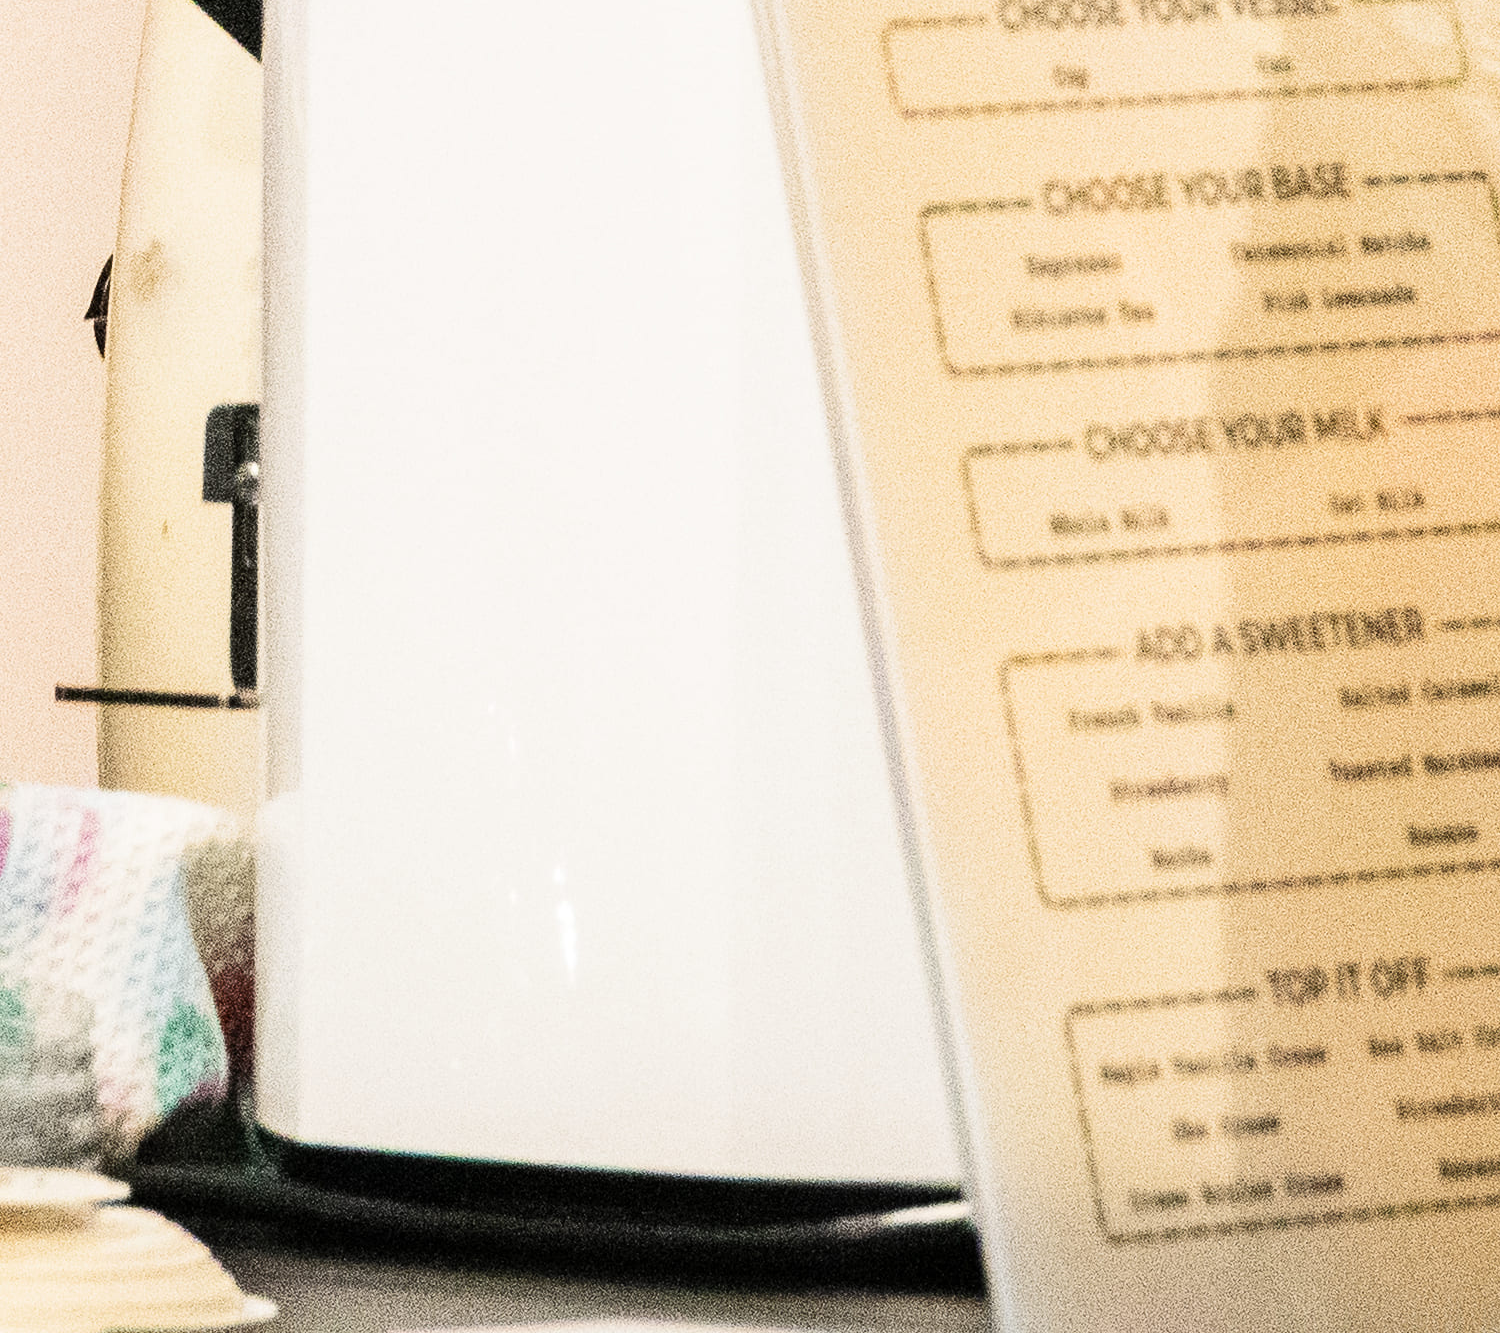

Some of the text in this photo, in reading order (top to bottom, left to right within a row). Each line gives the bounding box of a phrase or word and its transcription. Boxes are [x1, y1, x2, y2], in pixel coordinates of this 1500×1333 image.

[1044, 163, 1349, 215] CHOOSE YOUR BASE
[1084, 408, 1384, 460] CHOOSE YOUR MILK
[1134, 608, 1424, 662] ADD A SWEETENER
[1111, 774, 1229, 802] Strawberry
[1266, 957, 1430, 1005] TOP IT OFF
